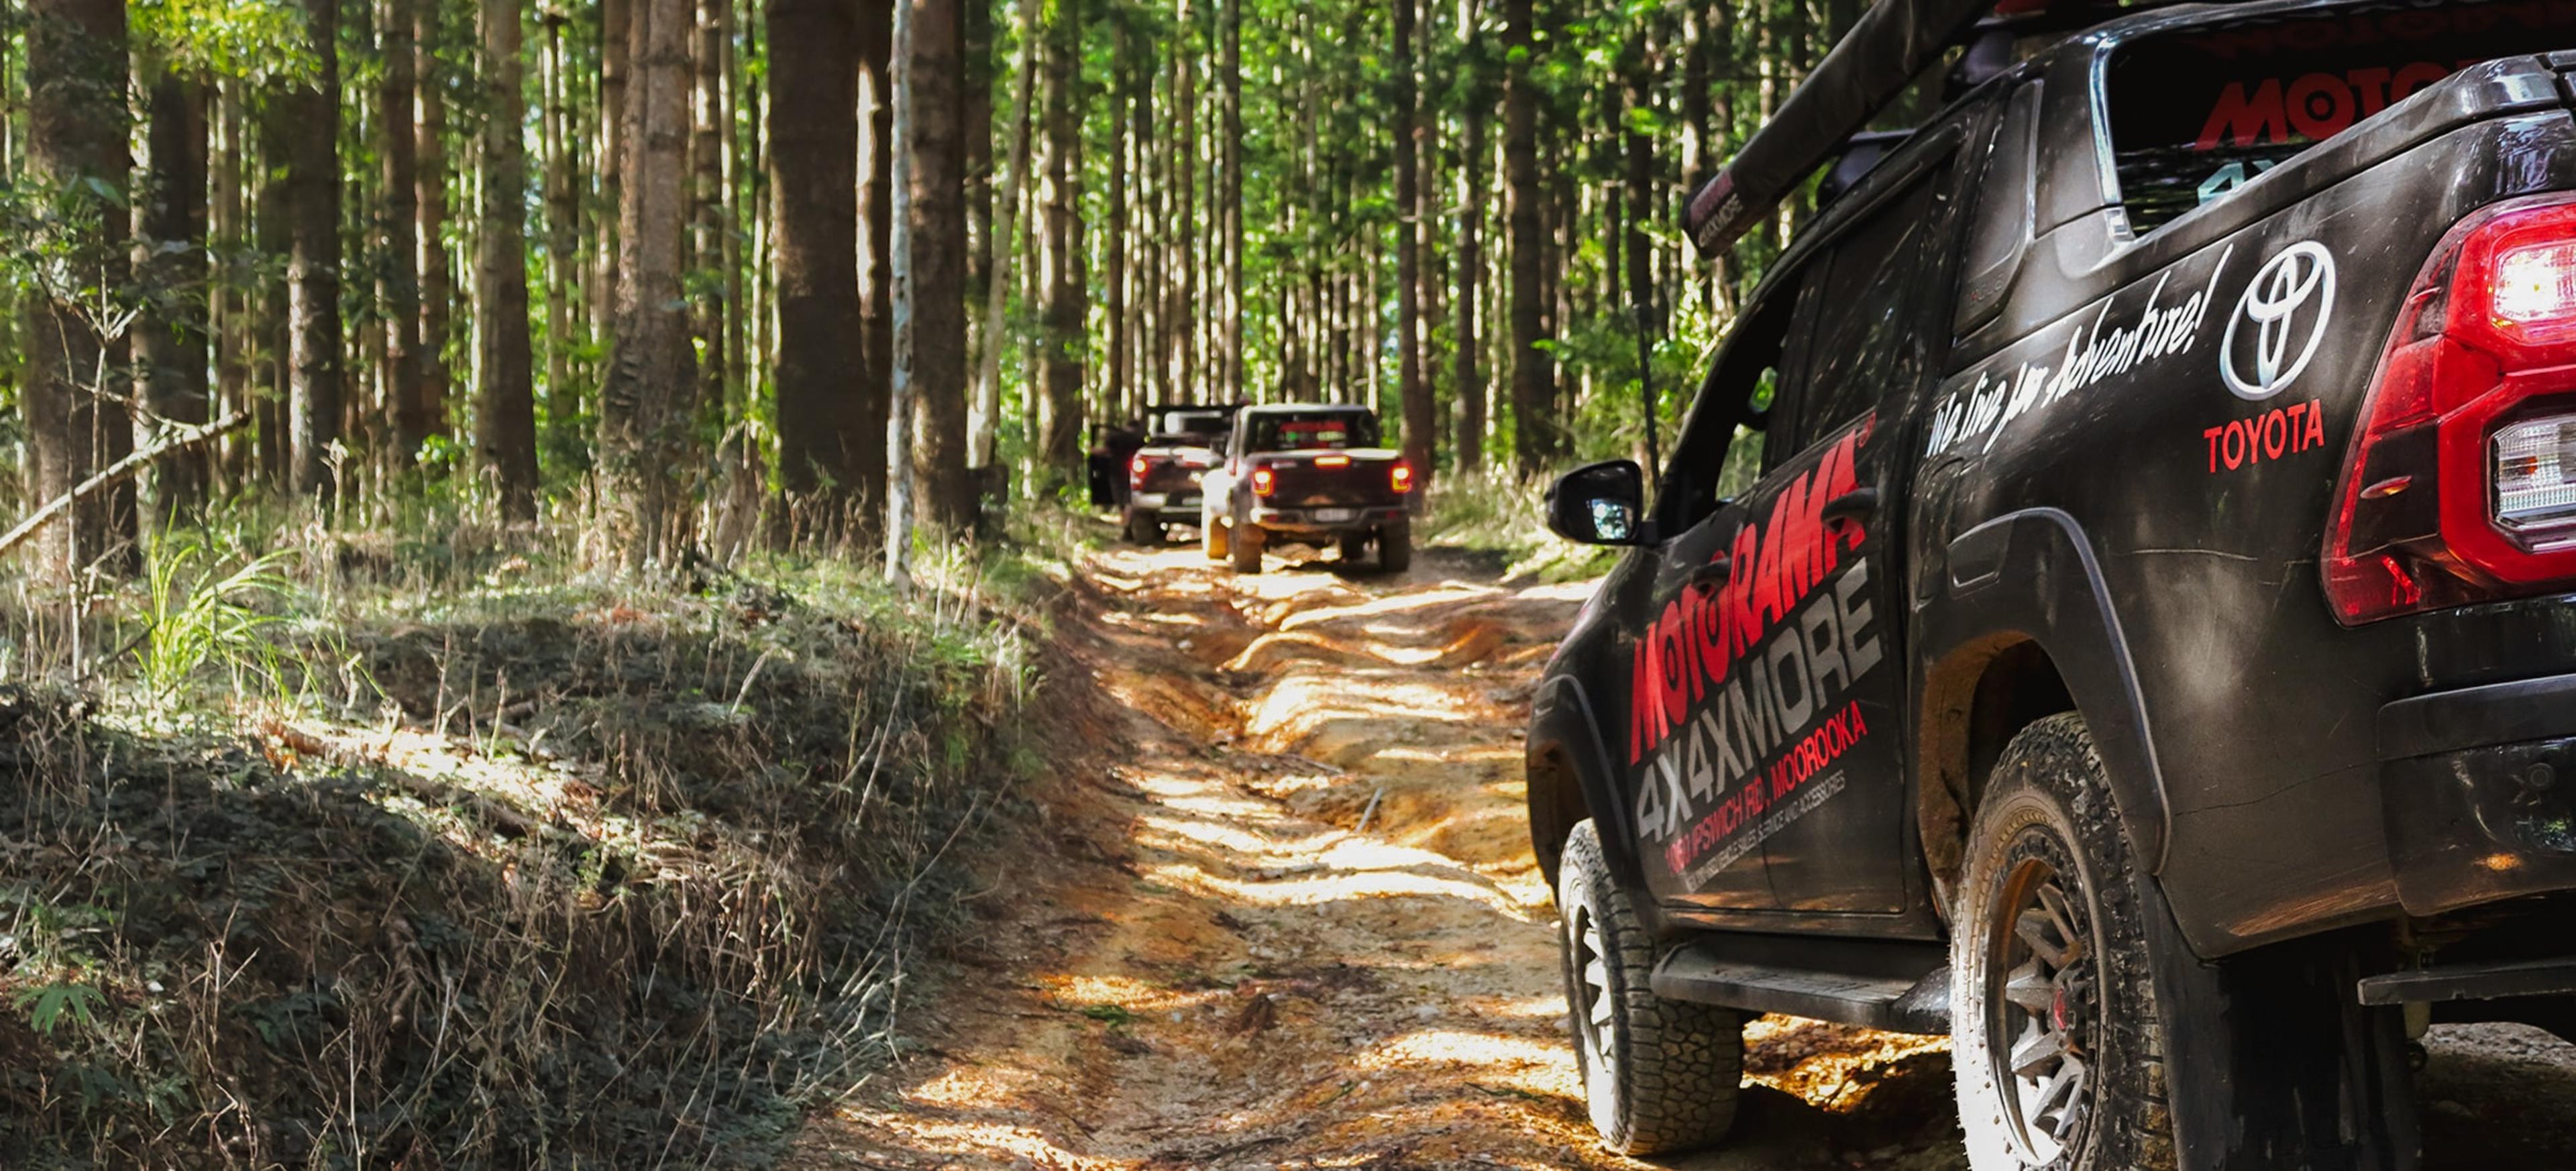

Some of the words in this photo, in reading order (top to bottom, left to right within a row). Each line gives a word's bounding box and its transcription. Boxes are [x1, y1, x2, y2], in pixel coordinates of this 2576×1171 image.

[2193, 59, 2483, 151] MOT
[1927, 391, 1963, 459] We
[1957, 370, 2007, 444] live
[2041, 242, 2234, 408] Adventure!
[2204, 398, 2325, 473] TOYOTA
[1631, 429, 1866, 765] MOTORAMA
[1637, 557, 1883, 842] 4X4XMORE
[1691, 791, 1743, 857] IPSWICH
[1770, 700, 1868, 801] MOOROOKA
